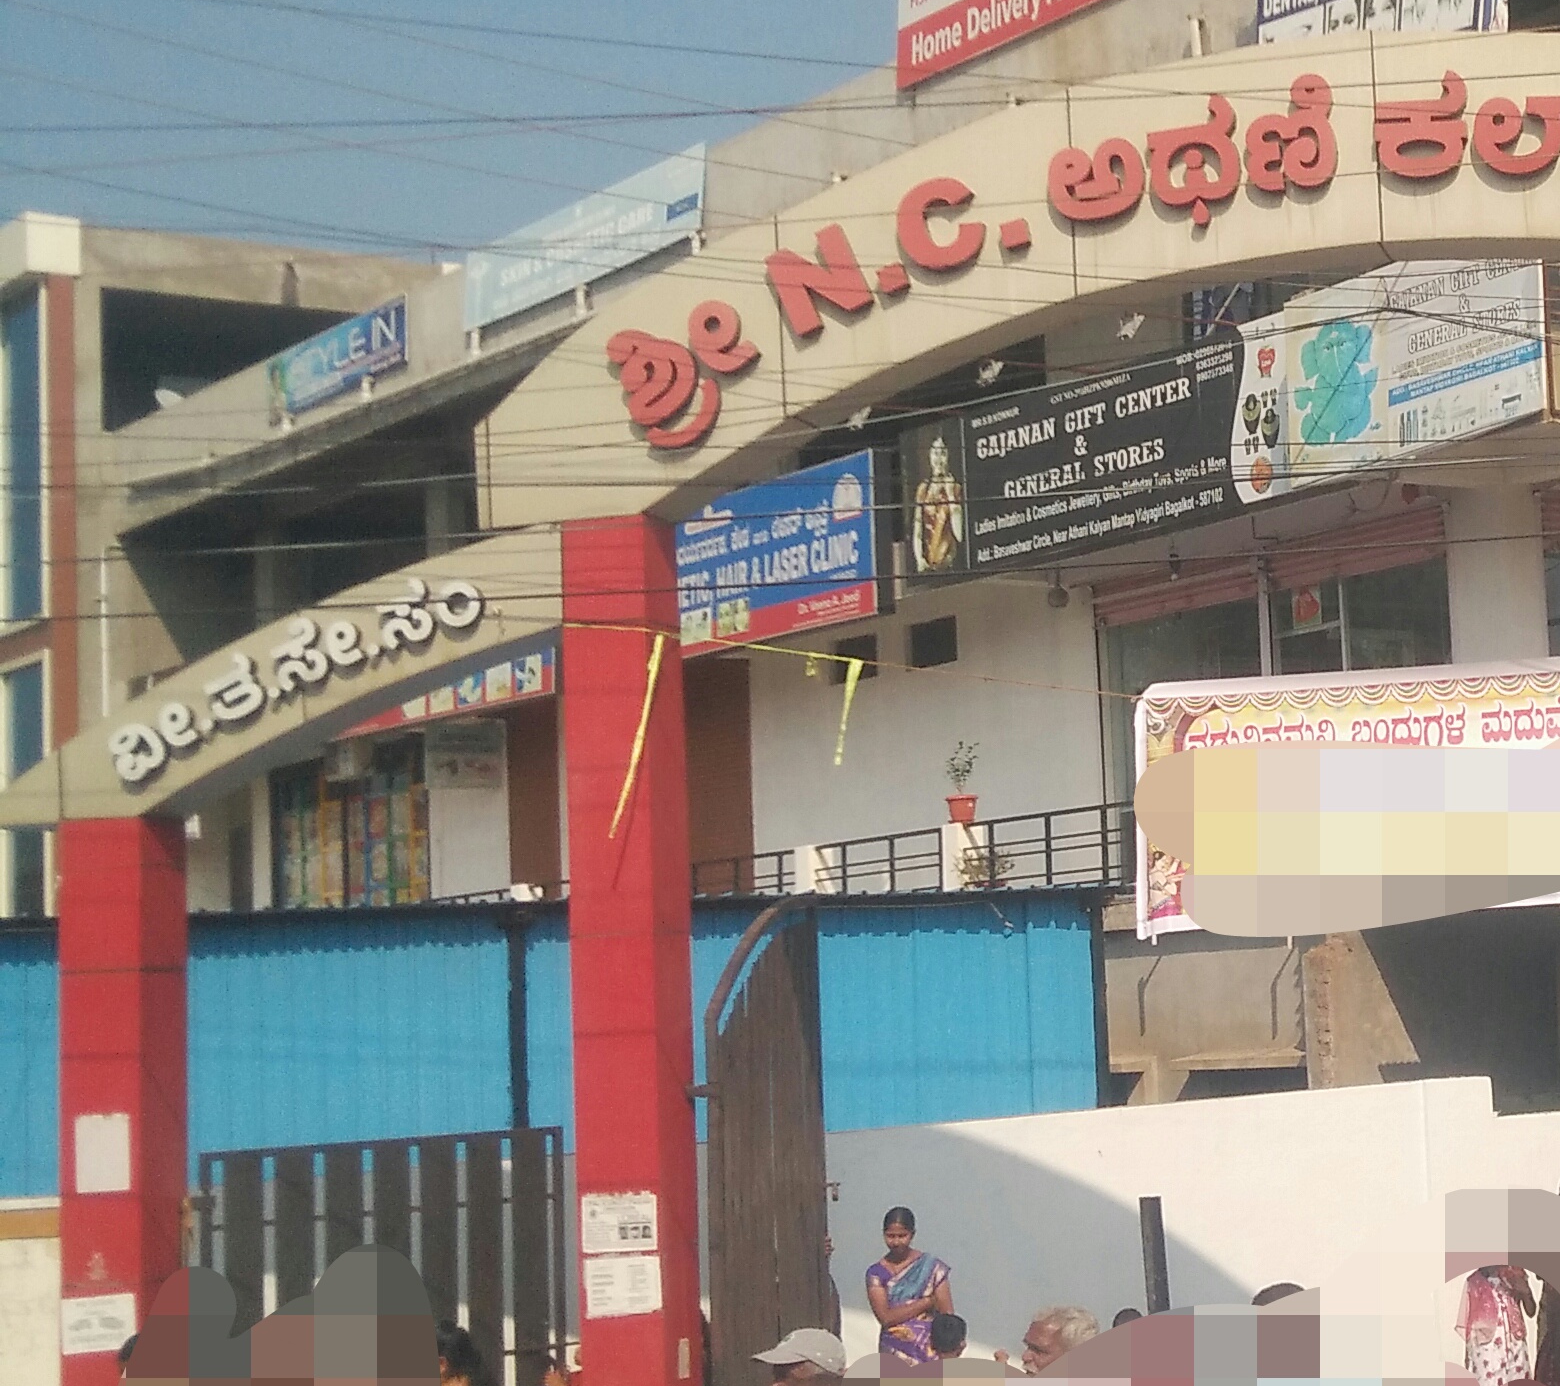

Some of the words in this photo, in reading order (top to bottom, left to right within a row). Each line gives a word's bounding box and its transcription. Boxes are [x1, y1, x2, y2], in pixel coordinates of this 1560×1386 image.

[911, 21, 962, 65] Home
[1459, 293, 1470, 312] &
[1408, 317, 1468, 354] GENERAL
[606, 299, 762, 449] ಶ್ರೀ
[976, 417, 1055, 460] GAJANAN
[1064, 402, 1106, 433] GIFT
[1115, 376, 1192, 419] CENTER
[1074, 434, 1088, 457] &
[1003, 461, 1086, 499] GENERAL
[1094, 438, 1165, 478] STORES
[1032, 499, 1067, 522] Cosmetics
[1053, 528, 1068, 545] Near
[1068, 523, 1089, 541] Athani
[1089, 517, 1111, 539] Kalyan
[717, 560, 748, 598] HAIR
[764, 543, 808, 583] LASER
[810, 530, 858, 573] CLINIC
